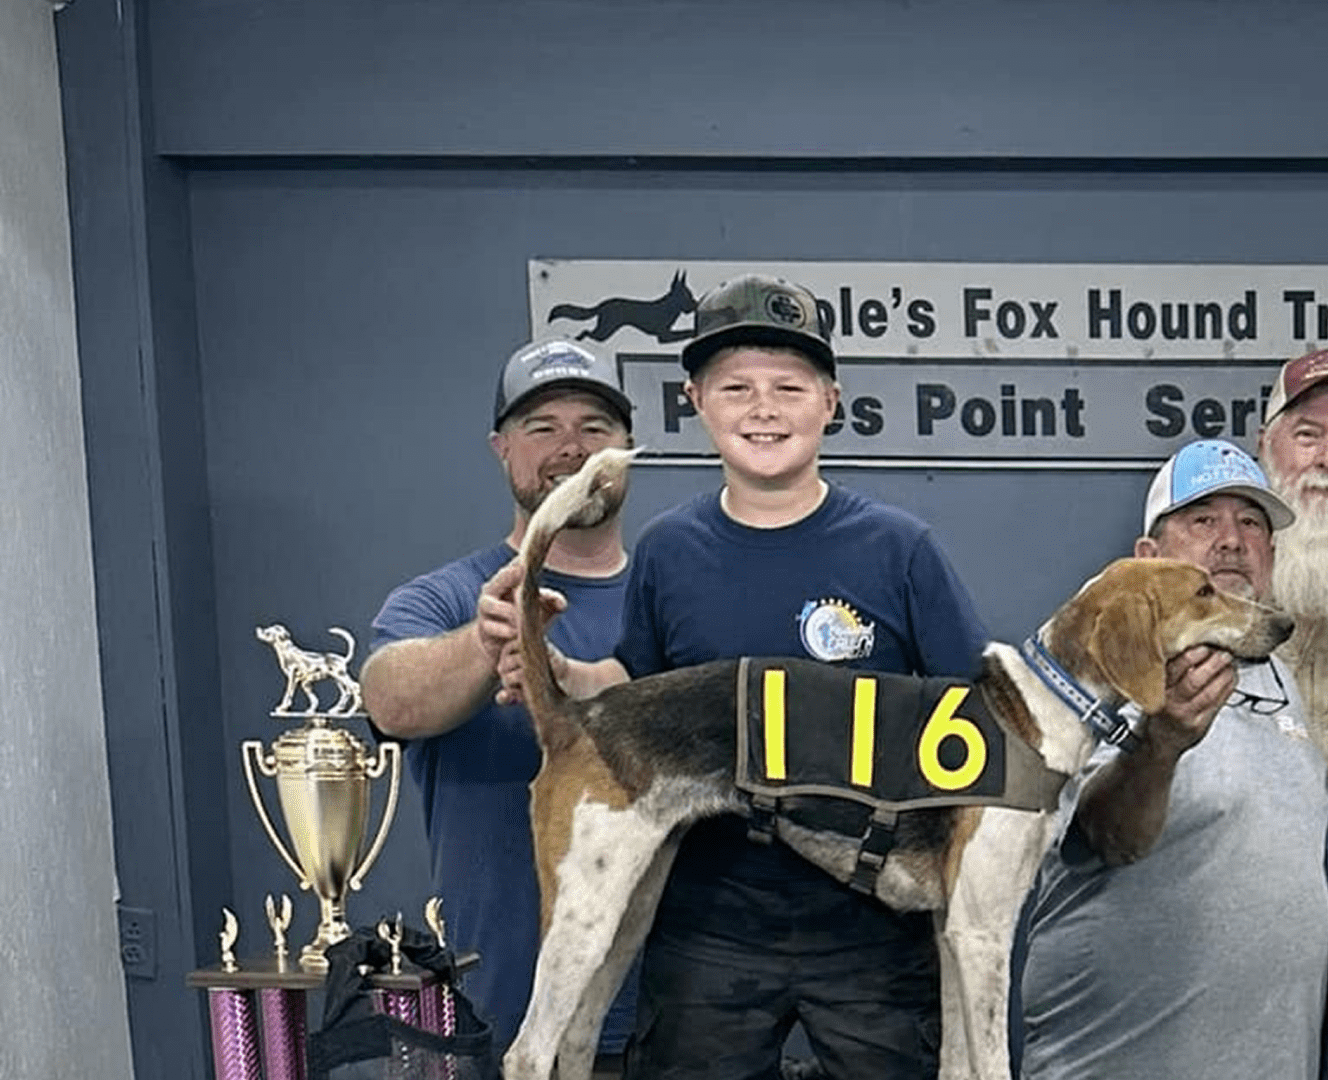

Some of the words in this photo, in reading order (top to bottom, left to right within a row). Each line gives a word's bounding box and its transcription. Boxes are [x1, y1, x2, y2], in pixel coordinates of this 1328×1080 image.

[817, 287, 936, 338] ole's
[964, 288, 1058, 338] Fox
[1088, 289, 1257, 340] Hound
[917, 384, 1086, 437] Point
[764, 669, 987, 791] 116
